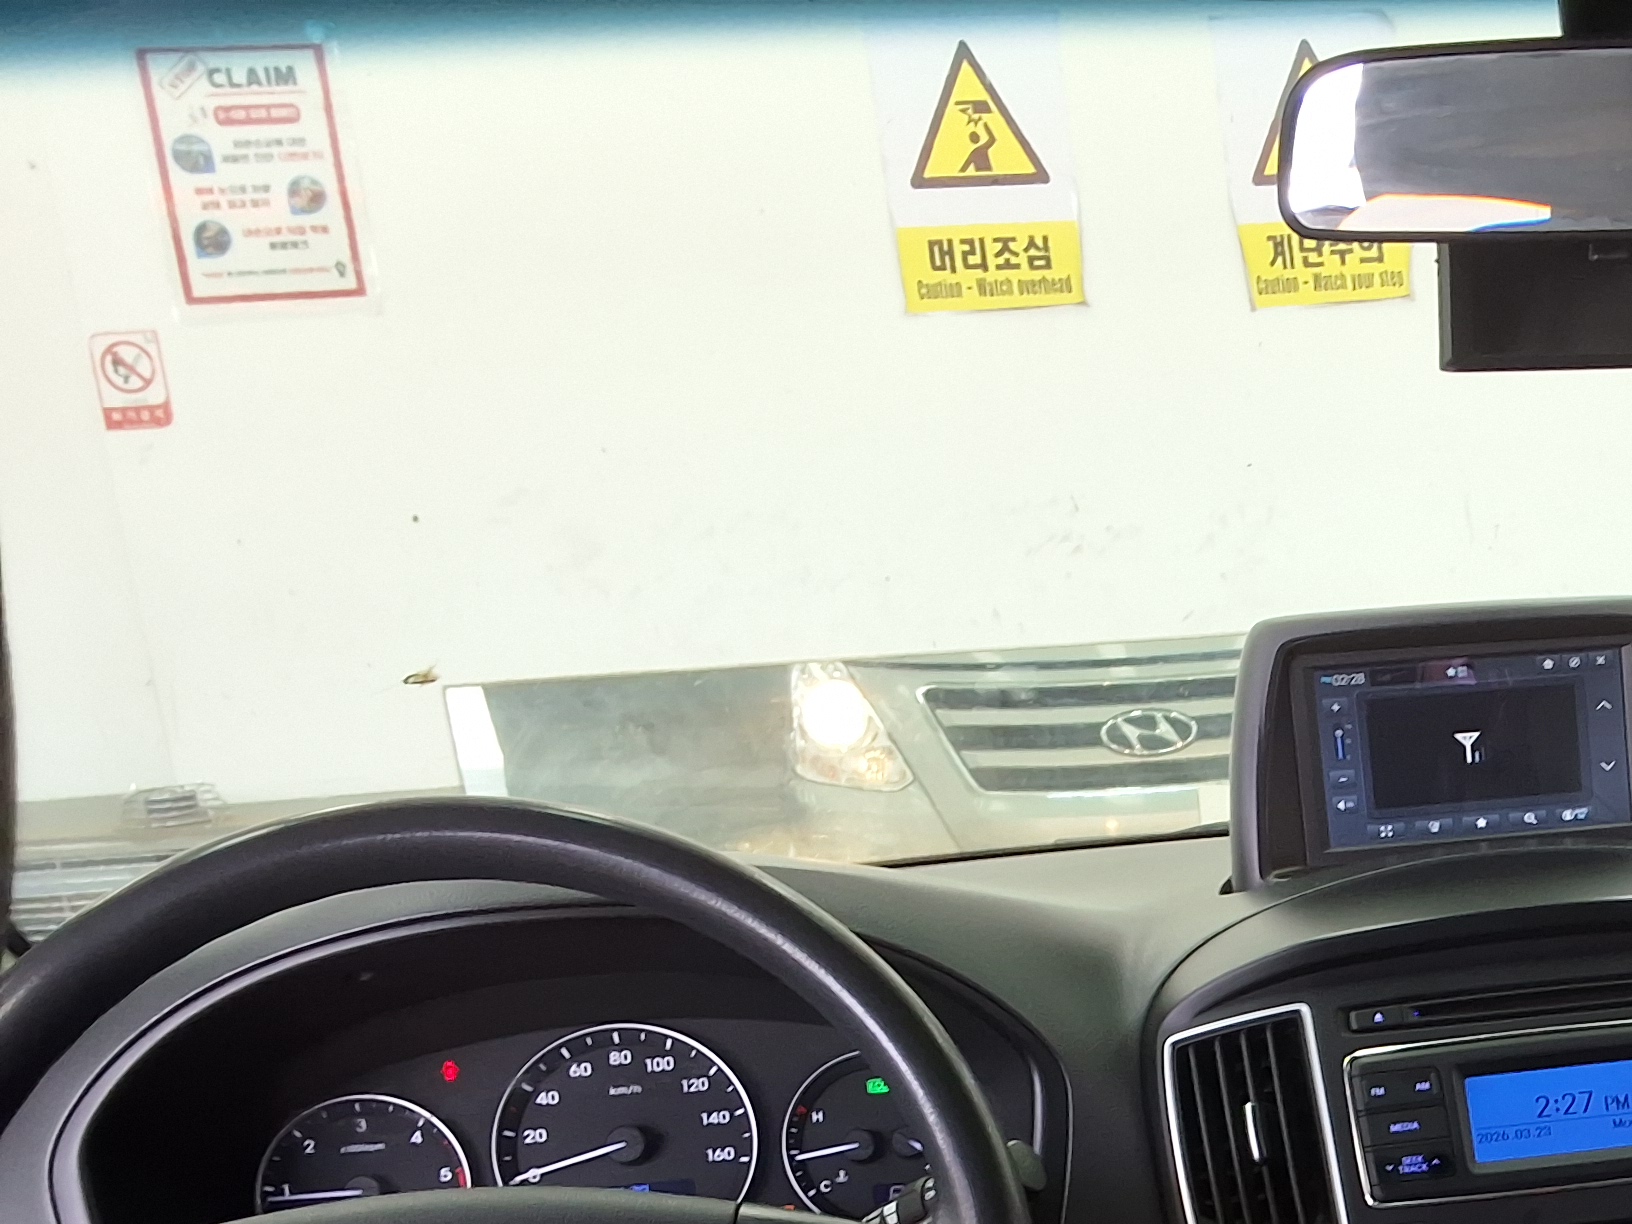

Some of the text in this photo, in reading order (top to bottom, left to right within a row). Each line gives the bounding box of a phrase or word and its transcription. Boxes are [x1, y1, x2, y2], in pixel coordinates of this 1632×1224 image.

[207, 65, 298, 88] CLAIM
[927, 235, 1053, 274] 머리조심
[916, 274, 1073, 300] Caution Watch overhead
[1256, 269, 1404, 296] Caution Watch your step
[608, 1050, 632, 1066] 80
[644, 1056, 675, 1072] 100
[568, 1062, 592, 1078] 60
[681, 1077, 709, 1093] 120
[534, 1090, 560, 1105] 40
[1535, 1090, 1630, 1119] 2:27 PM
[701, 1110, 731, 1125] 140
[811, 1110, 825, 1123] H
[355, 1118, 367, 1133] 3
[410, 1130, 423, 1144] 4
[522, 1128, 548, 1144] 20
[303, 1139, 316, 1154] 2
[705, 1146, 735, 1162] 160
[438, 1167, 453, 1183] 5
[819, 1179, 833, 1193] C
